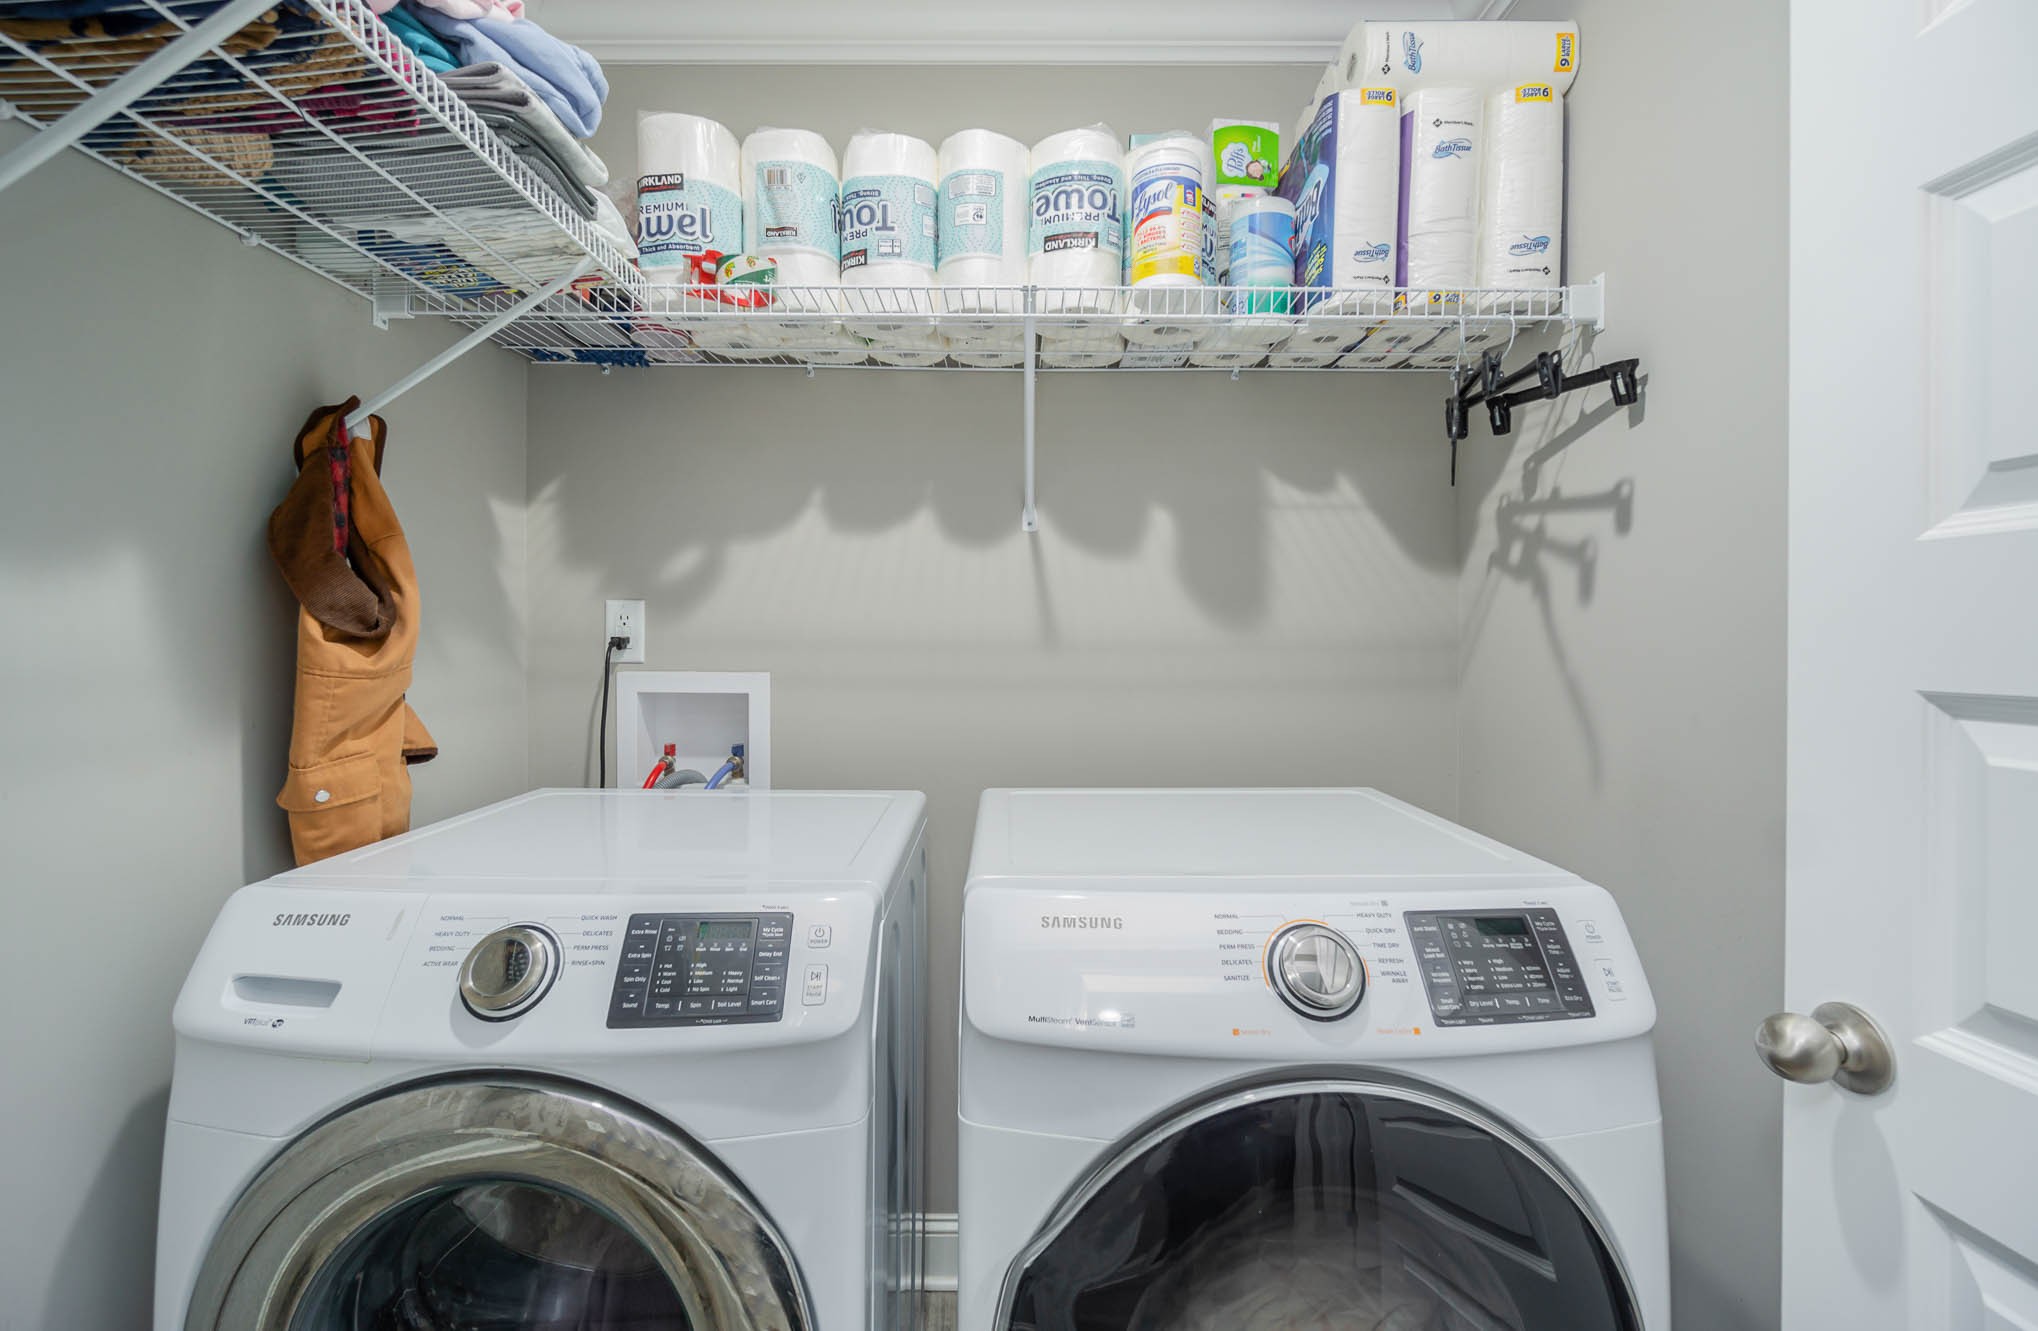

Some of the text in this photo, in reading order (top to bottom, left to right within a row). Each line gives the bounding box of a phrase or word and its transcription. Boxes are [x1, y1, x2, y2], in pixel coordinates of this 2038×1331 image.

[1226, 147, 1246, 173] Puffs
[1136, 181, 1173, 217] Lysol
[640, 202, 682, 214] REMIUM
[1044, 237, 1096, 251] KIRKLAND
[272, 913, 351, 927] SAMSUNG
[1041, 915, 1123, 930] SAMSUNG
